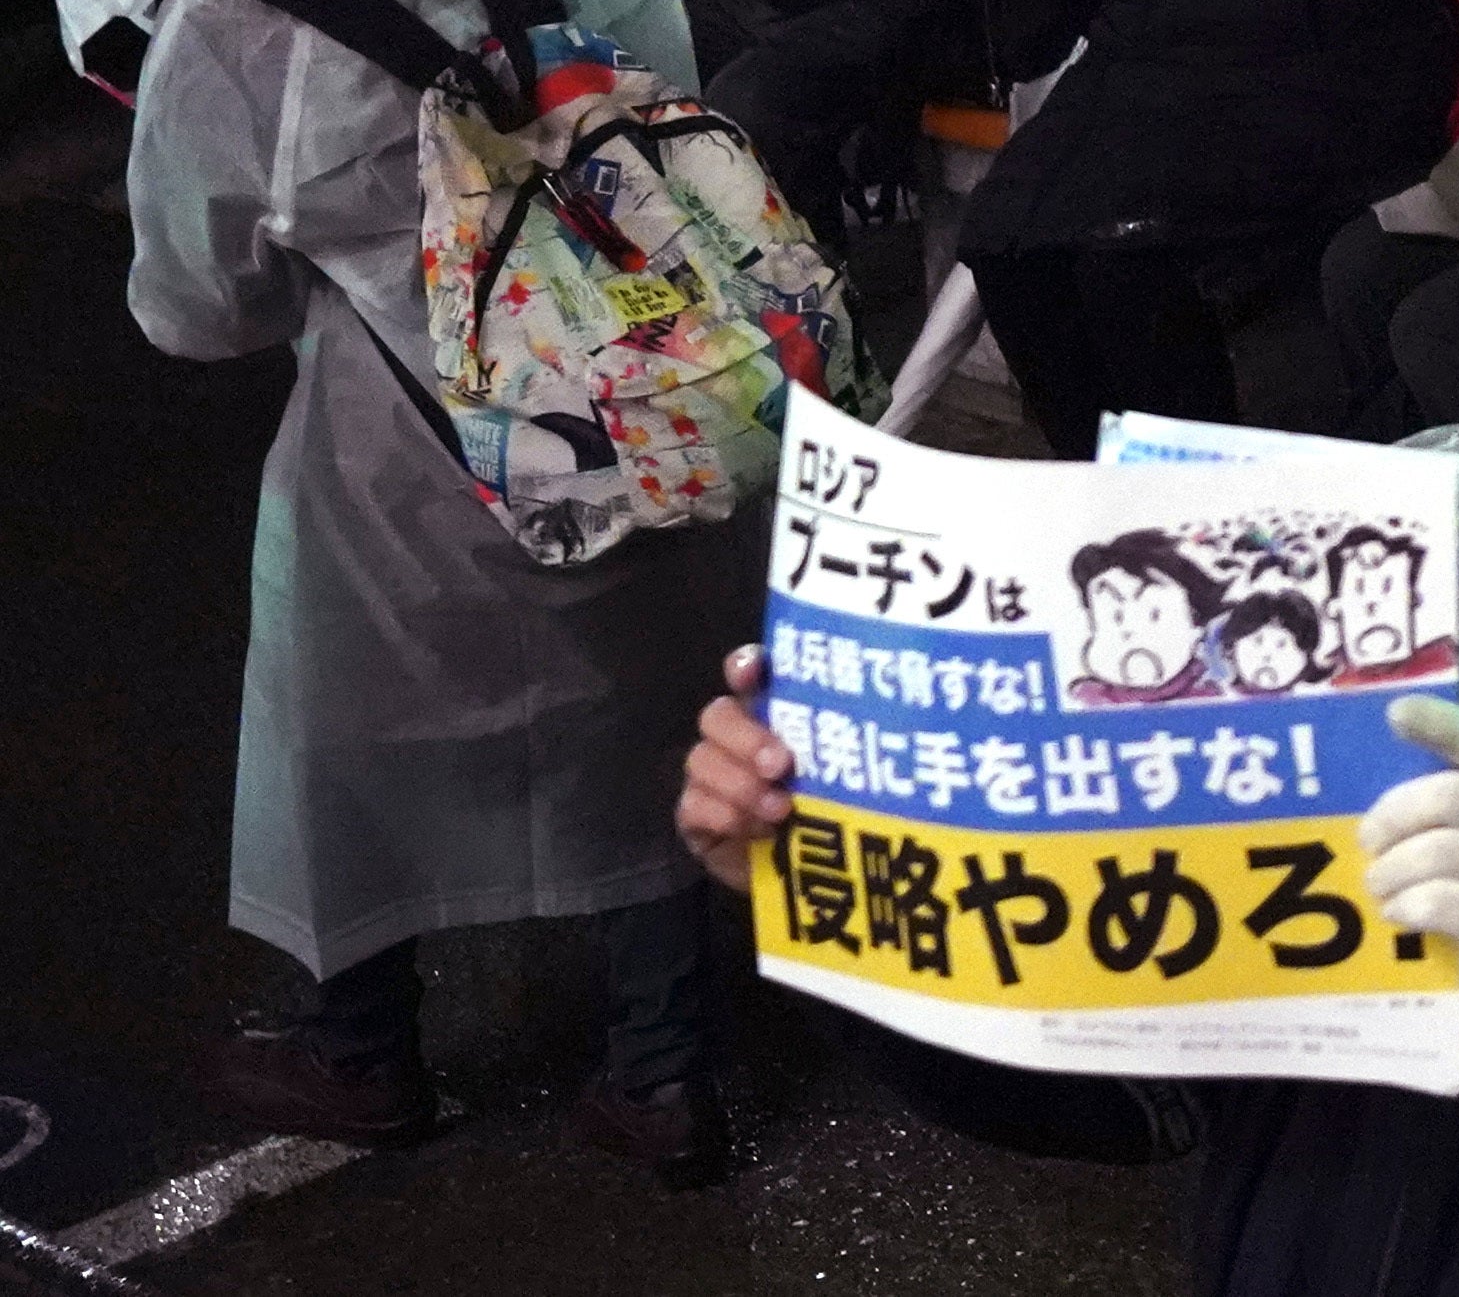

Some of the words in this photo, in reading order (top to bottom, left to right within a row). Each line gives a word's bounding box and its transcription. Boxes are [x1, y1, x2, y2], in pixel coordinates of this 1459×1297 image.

[795, 440, 881, 514] ロシア
[788, 518, 1030, 625] プーチンは
[771, 621, 1048, 716] 核兵器で脅すな!
[770, 701, 1321, 818] 原発に手を出すな!
